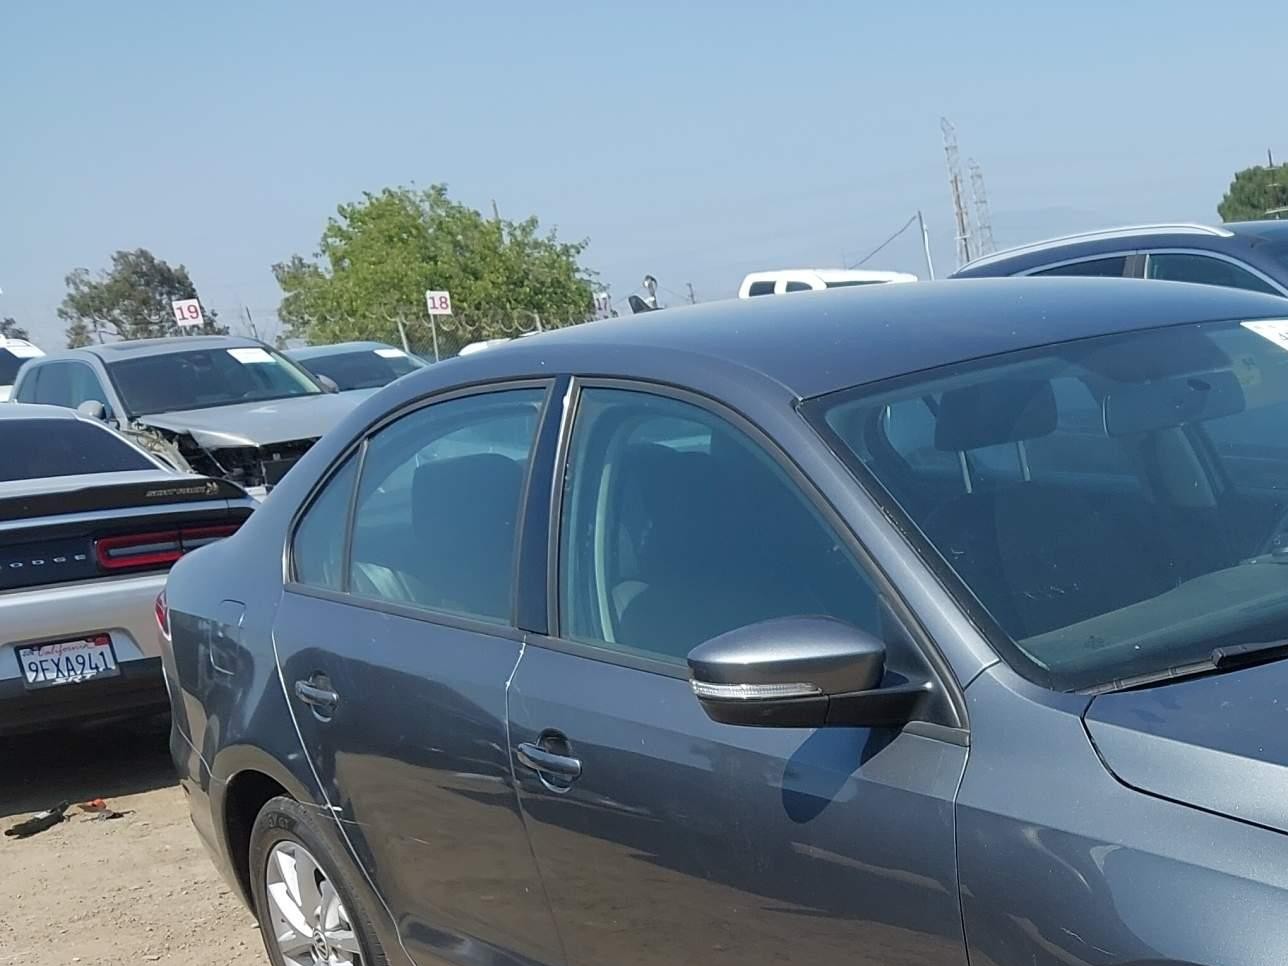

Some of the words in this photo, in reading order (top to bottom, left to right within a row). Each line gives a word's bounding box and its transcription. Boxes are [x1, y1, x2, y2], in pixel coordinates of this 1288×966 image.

[429, 296, 449, 310] 18
[596, 297, 608, 312] 17
[176, 304, 200, 321] 19
[0, 553, 86, 568] ODGE
[28, 651, 112, 682] 9FXA941
[52, 672, 96, 685] SRT
